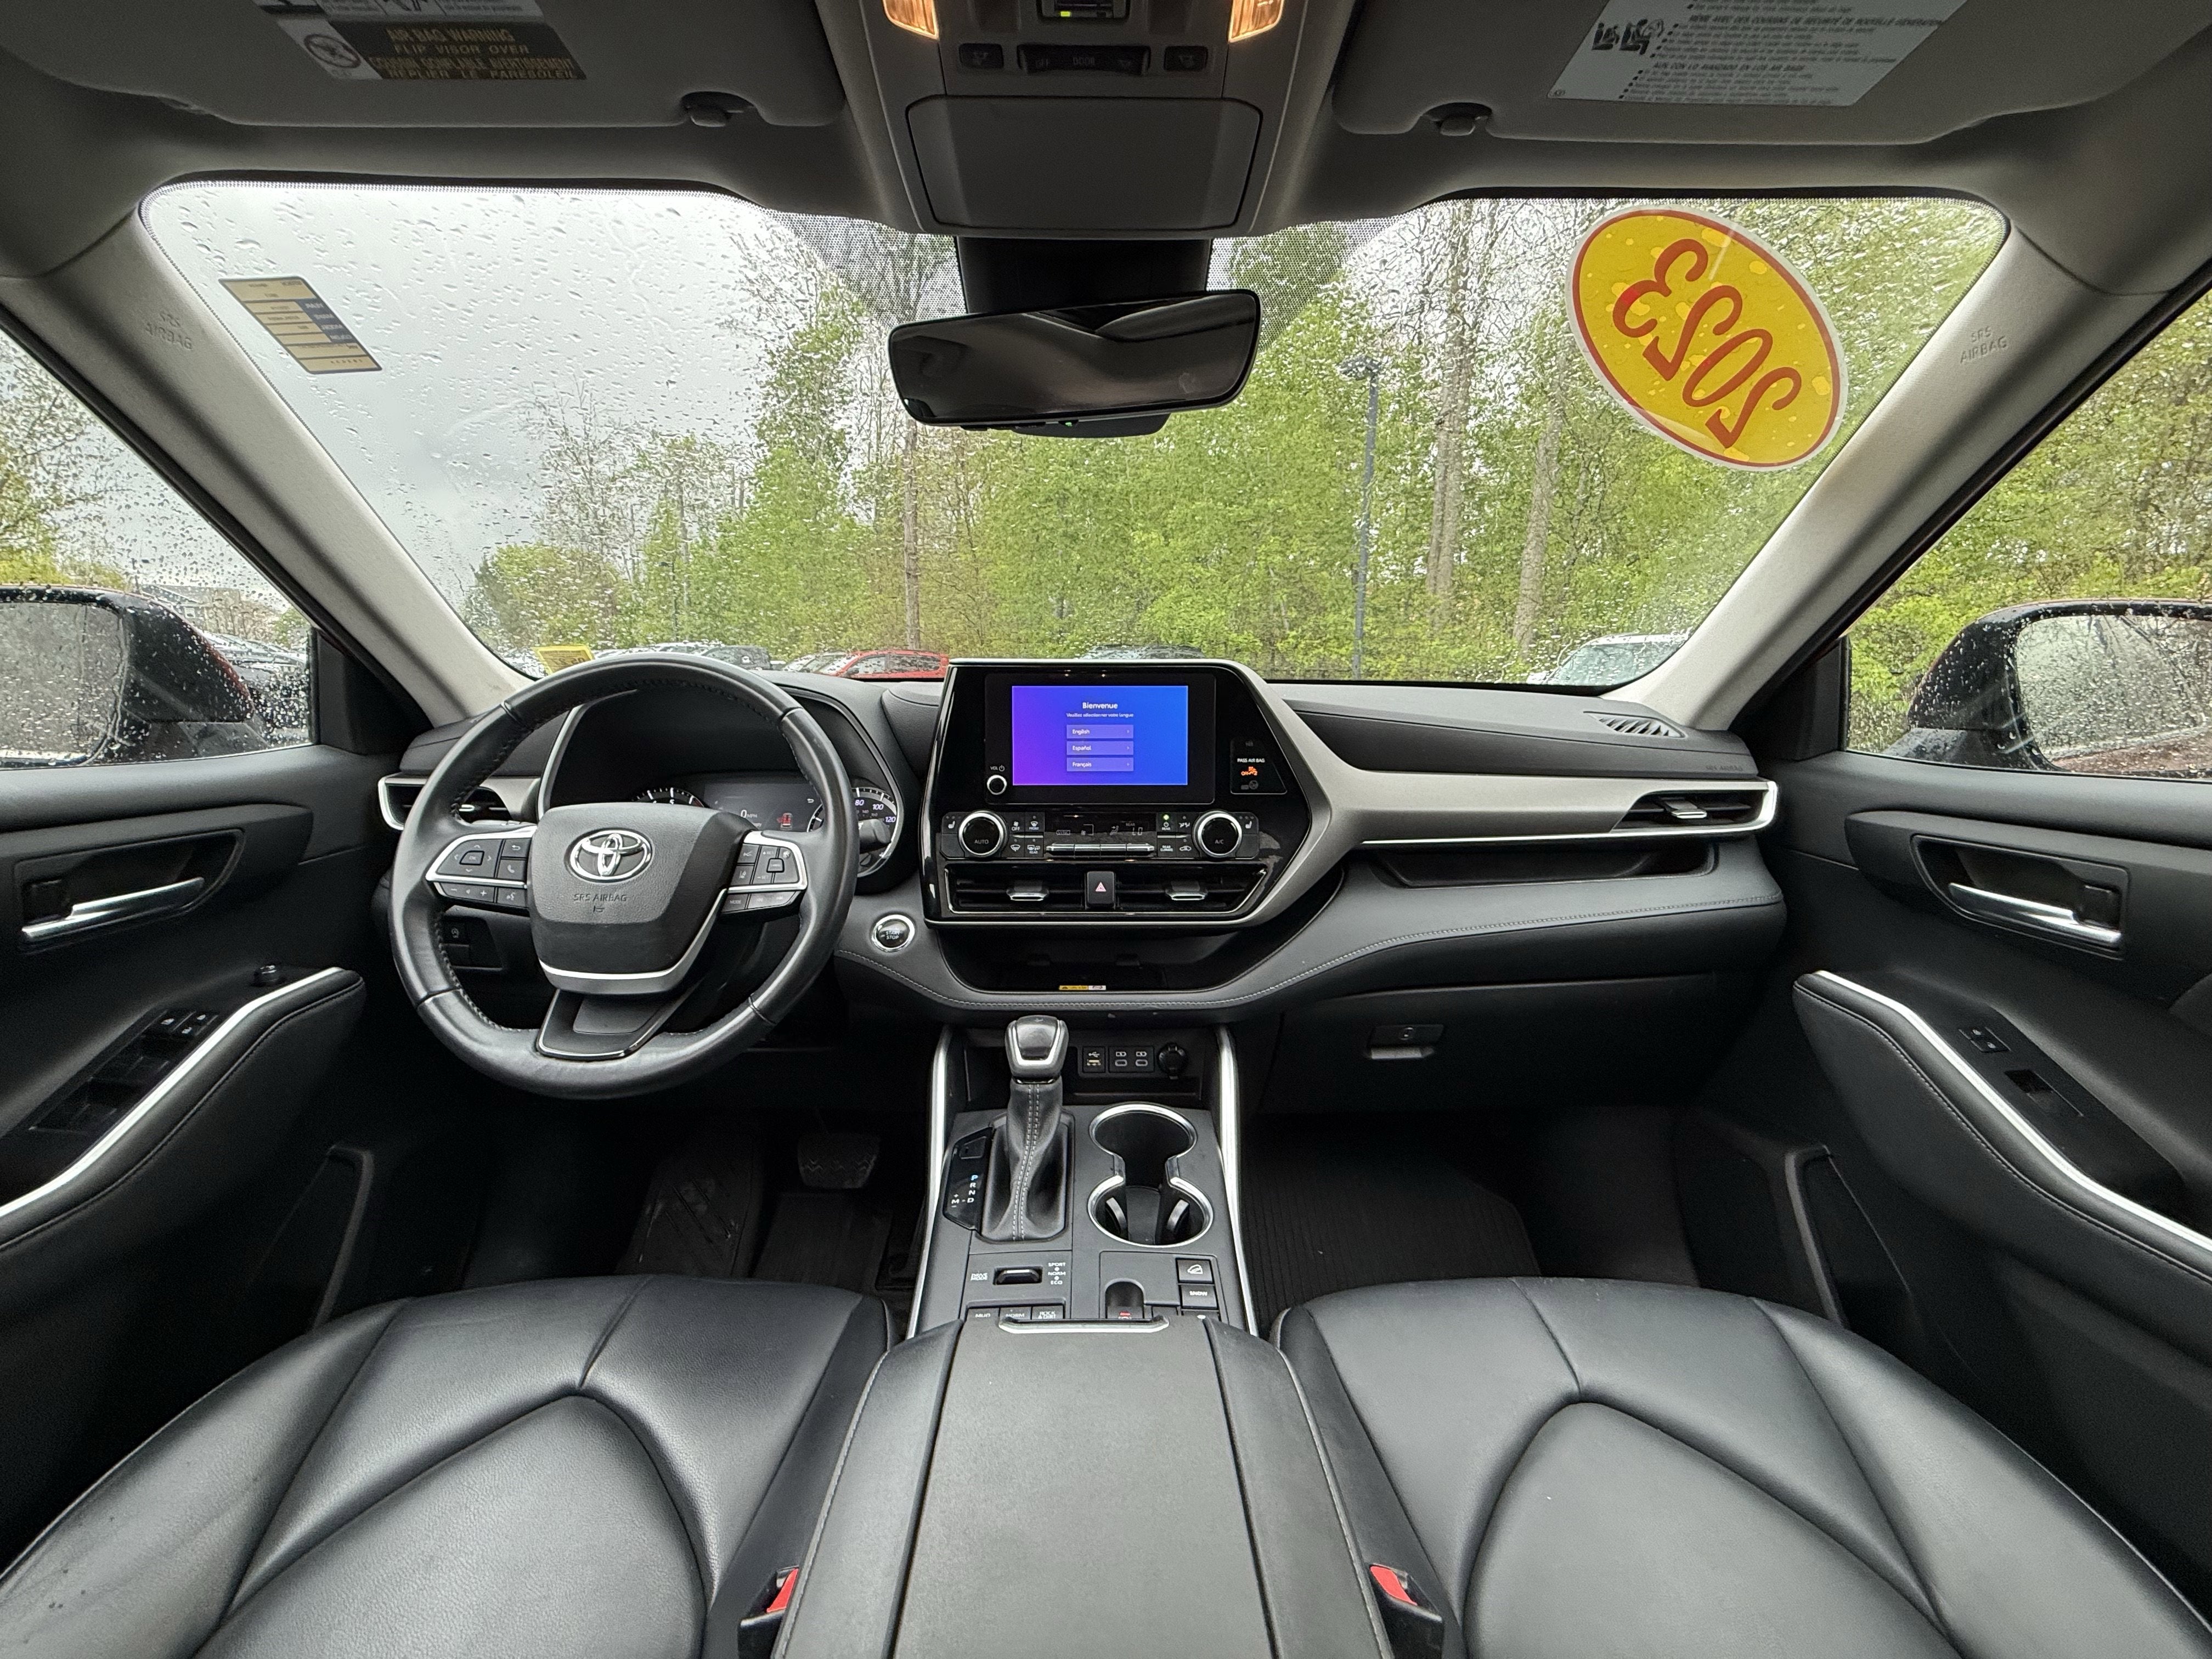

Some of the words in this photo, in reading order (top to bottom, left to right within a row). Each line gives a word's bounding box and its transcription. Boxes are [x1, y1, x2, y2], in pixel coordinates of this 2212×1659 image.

[436, 44, 481, 54] VISOR
[488, 44, 529, 54] OVER
[1960, 335, 2007, 364] AIRBAG
[741, 810, 747, 818] 0
[592, 893, 627, 902] AIRBAG
